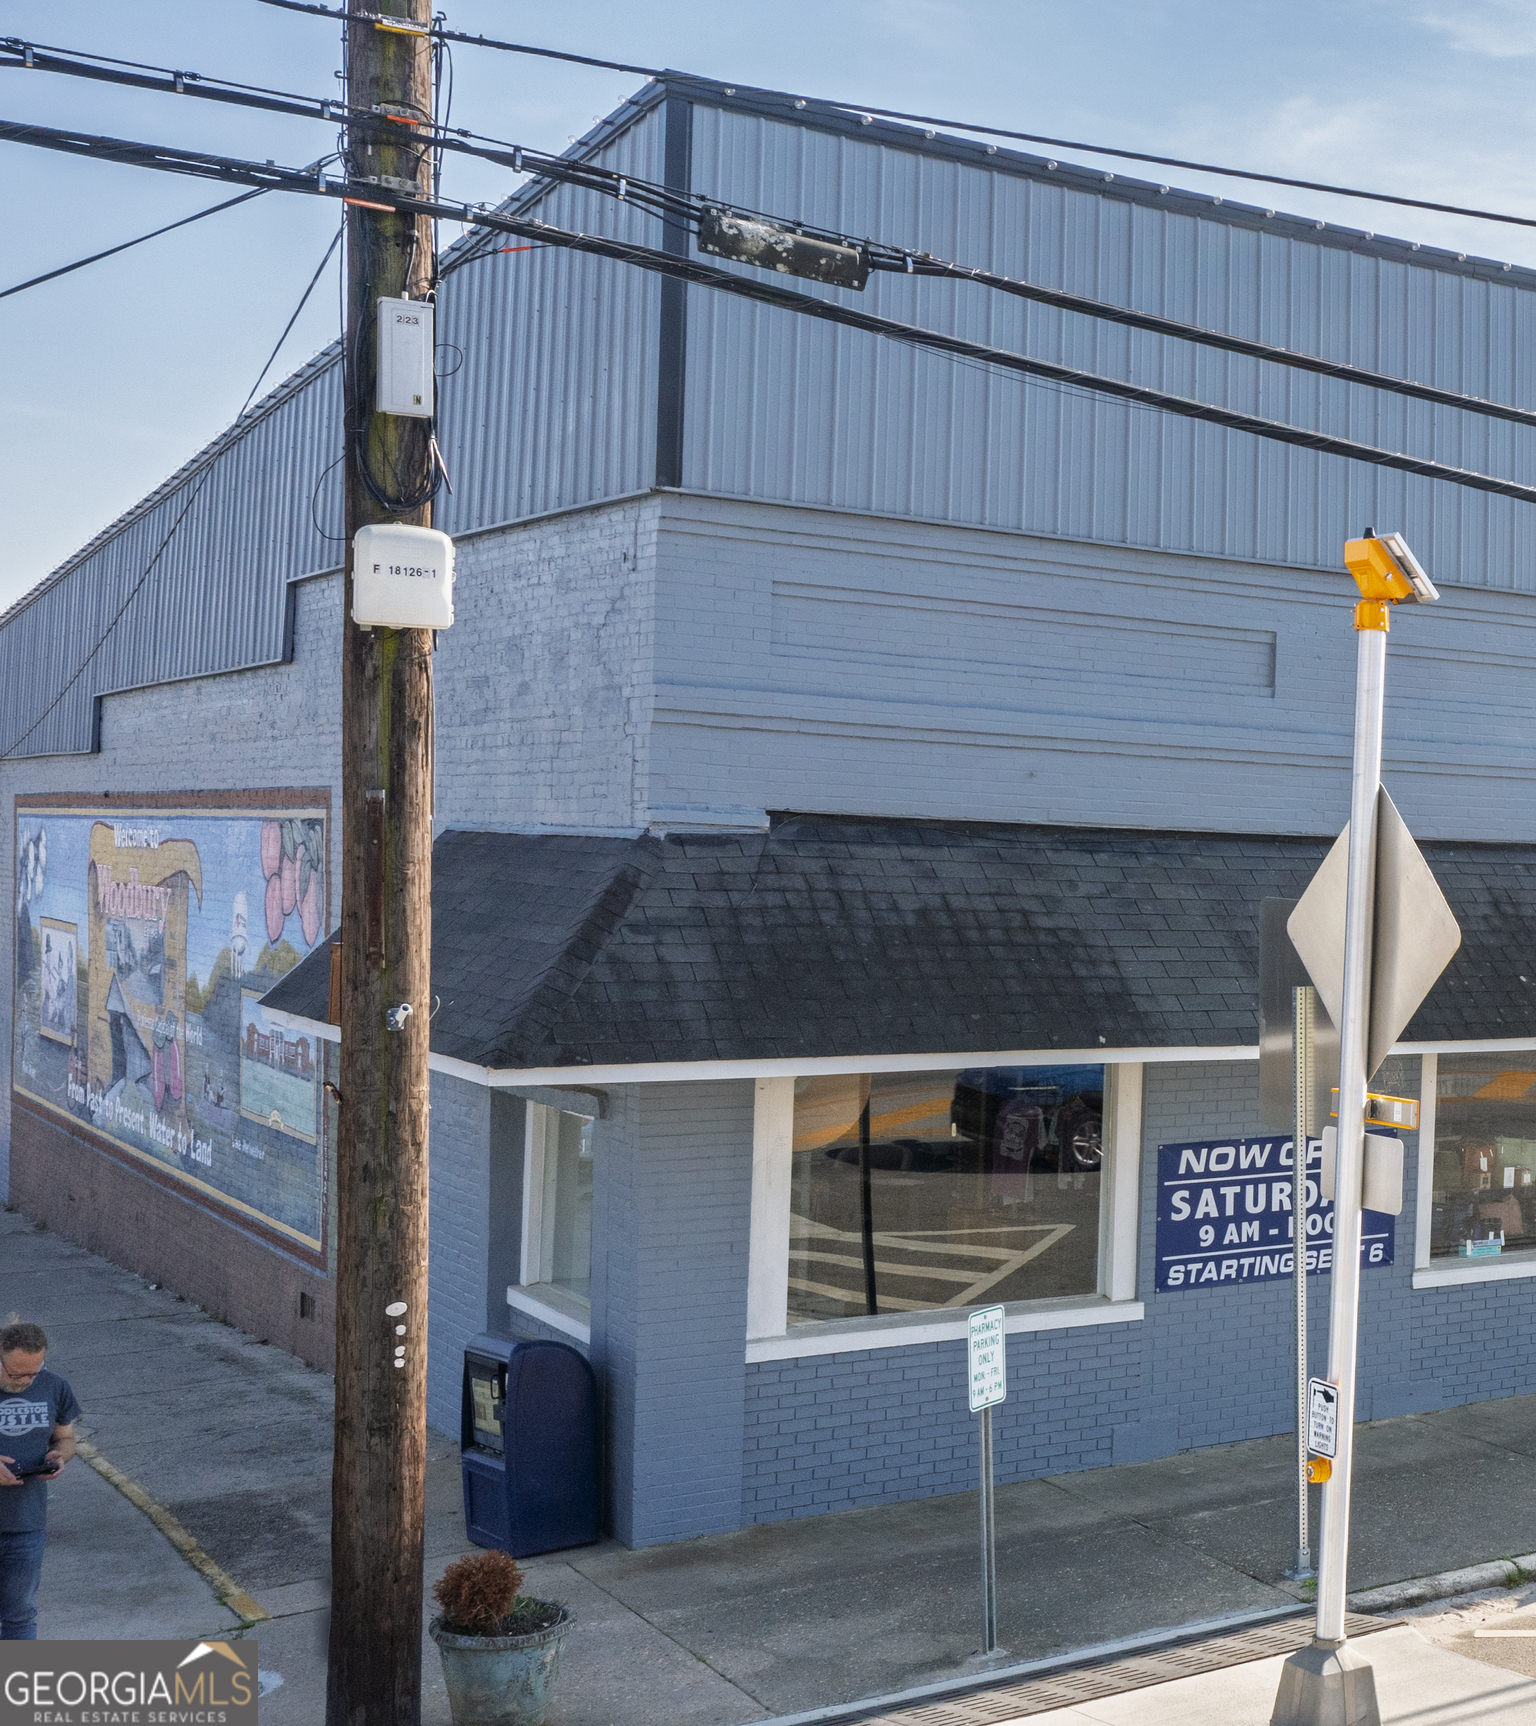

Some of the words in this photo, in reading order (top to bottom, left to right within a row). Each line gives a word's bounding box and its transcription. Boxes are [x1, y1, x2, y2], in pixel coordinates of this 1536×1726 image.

[396, 315, 419, 325] 223
[113, 822, 148, 848] Welcome
[149, 828, 159, 849] to
[96, 864, 171, 934] Woodbury
[67, 1073, 85, 1105] From
[150, 1111, 175, 1149] Water
[177, 1121, 187, 1156] to
[190, 1128, 213, 1167] Land
[1178, 1144, 1272, 1174] NOW
[1199, 1224, 1215, 1247] 9
[1223, 1220, 1260, 1244] AM
[1167, 1254, 1294, 1286] STARTING
[1368, 1243, 1384, 1262] 6
[971, 1317, 1002, 1338] PHARMACY
[973, 1333, 1000, 1352] PARKING
[978, 1350, 995, 1366] ONLY
[977, 1386, 985, 1397] AM
[994, 1380, 1002, 1391] PM
[1317, 1403, 1329, 1413] PUSH
[1311, 1411, 1327, 1422] BUTTON
[1329, 1416, 1335, 1425] TO
[1313, 1420, 1324, 1430] TURN
[1326, 1424, 1332, 1433] ON
[1313, 1430, 1331, 1443] WARNING
[1314, 1441, 1329, 1451] LIGHTS
